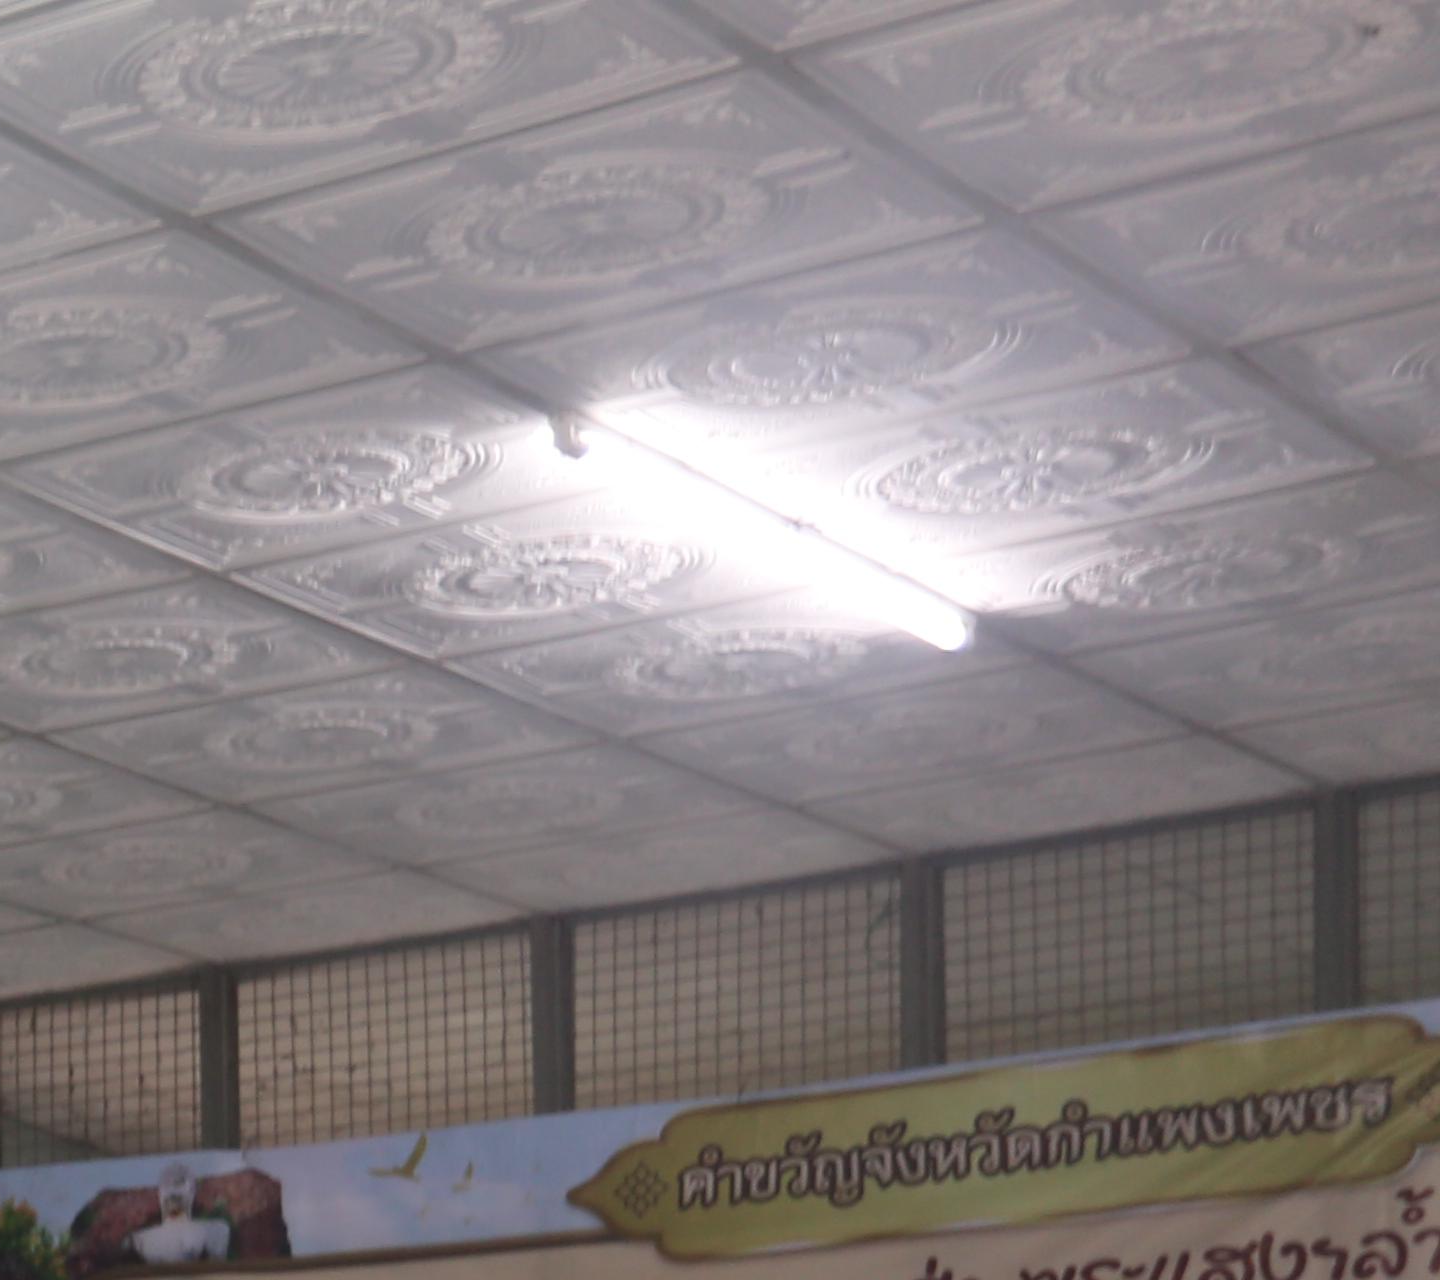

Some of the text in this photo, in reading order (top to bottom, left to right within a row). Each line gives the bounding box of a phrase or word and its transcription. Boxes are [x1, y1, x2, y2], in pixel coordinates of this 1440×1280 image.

[677, 1075, 1394, 1211] คำขวัญจังหวัดกำแพงเพชร
